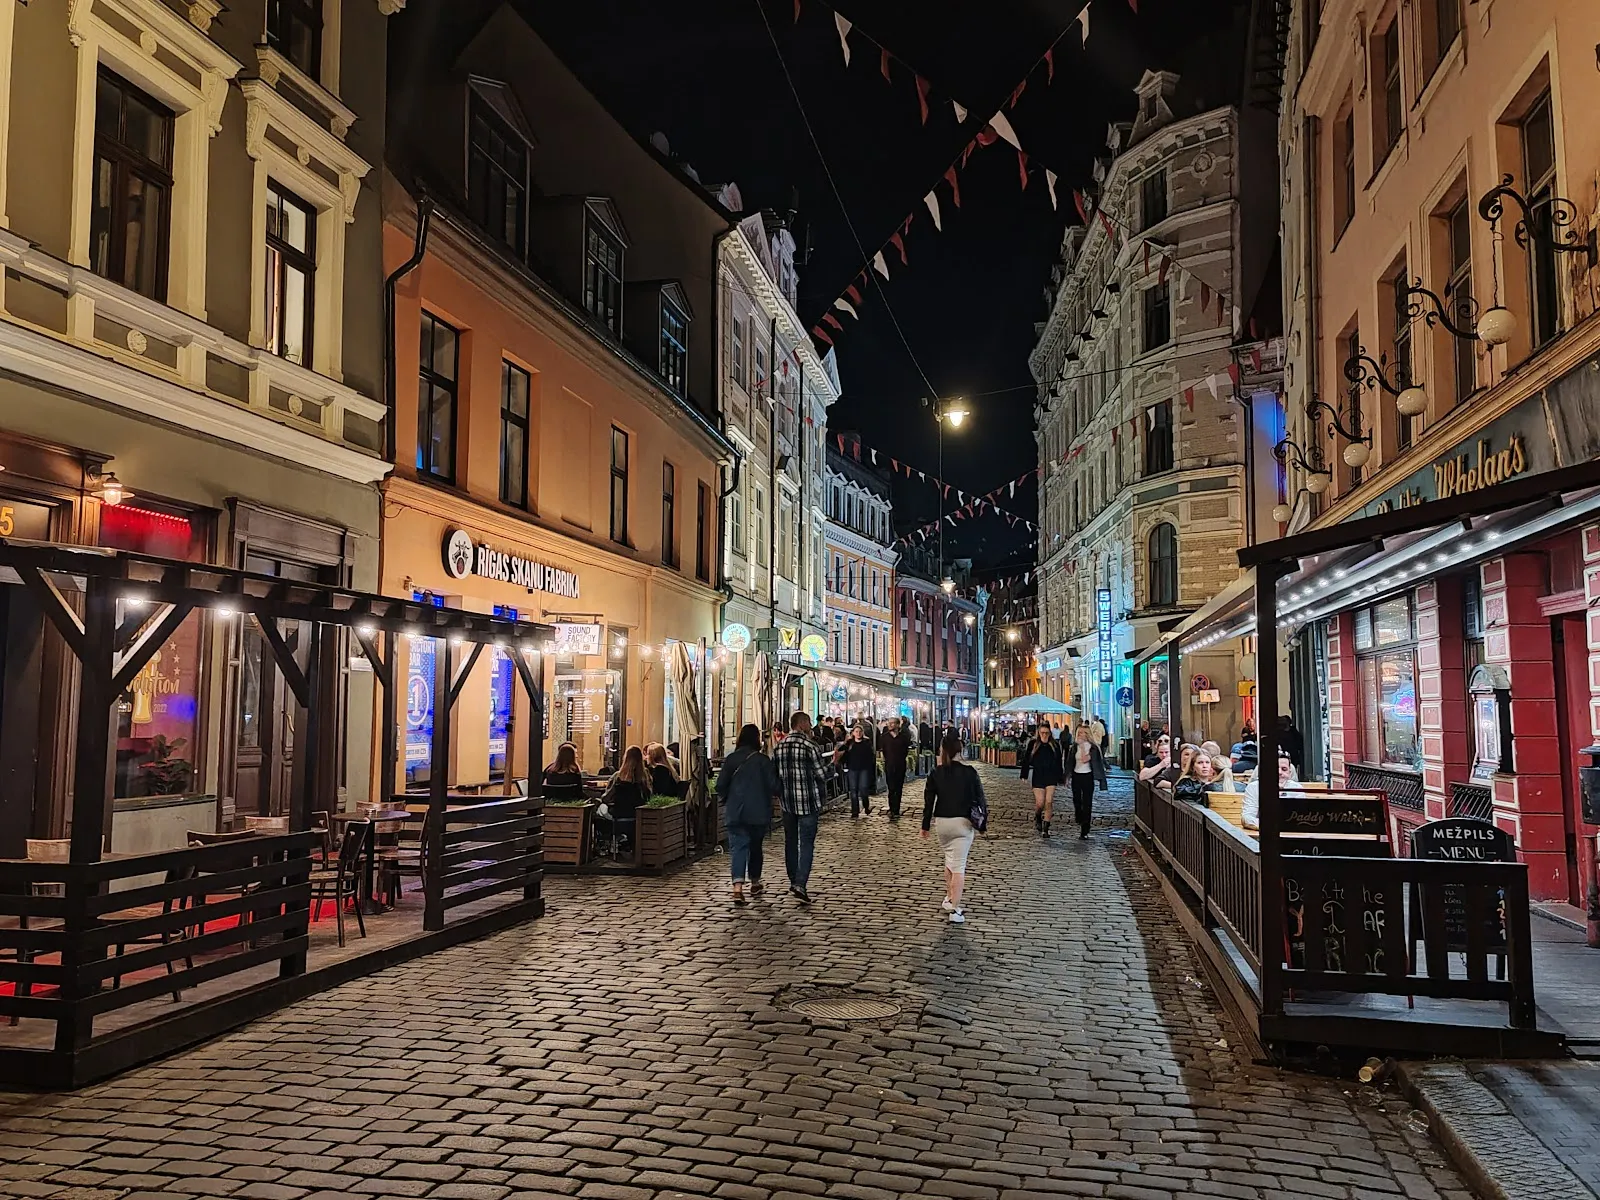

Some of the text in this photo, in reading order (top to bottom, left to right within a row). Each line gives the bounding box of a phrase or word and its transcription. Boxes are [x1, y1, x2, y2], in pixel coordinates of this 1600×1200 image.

[1432, 435, 1526, 500] Whelan's
[477, 544, 510, 582] RĪGAS
[545, 566, 580, 599] FABRIKA
[567, 626, 591, 635] SOUND
[1099, 591, 1112, 680] SWEATSHOP
[1286, 810, 1325, 827] Paddy
[1432, 826, 1495, 841] MEŽPILS
[1439, 846, 1486, 860] MENU
